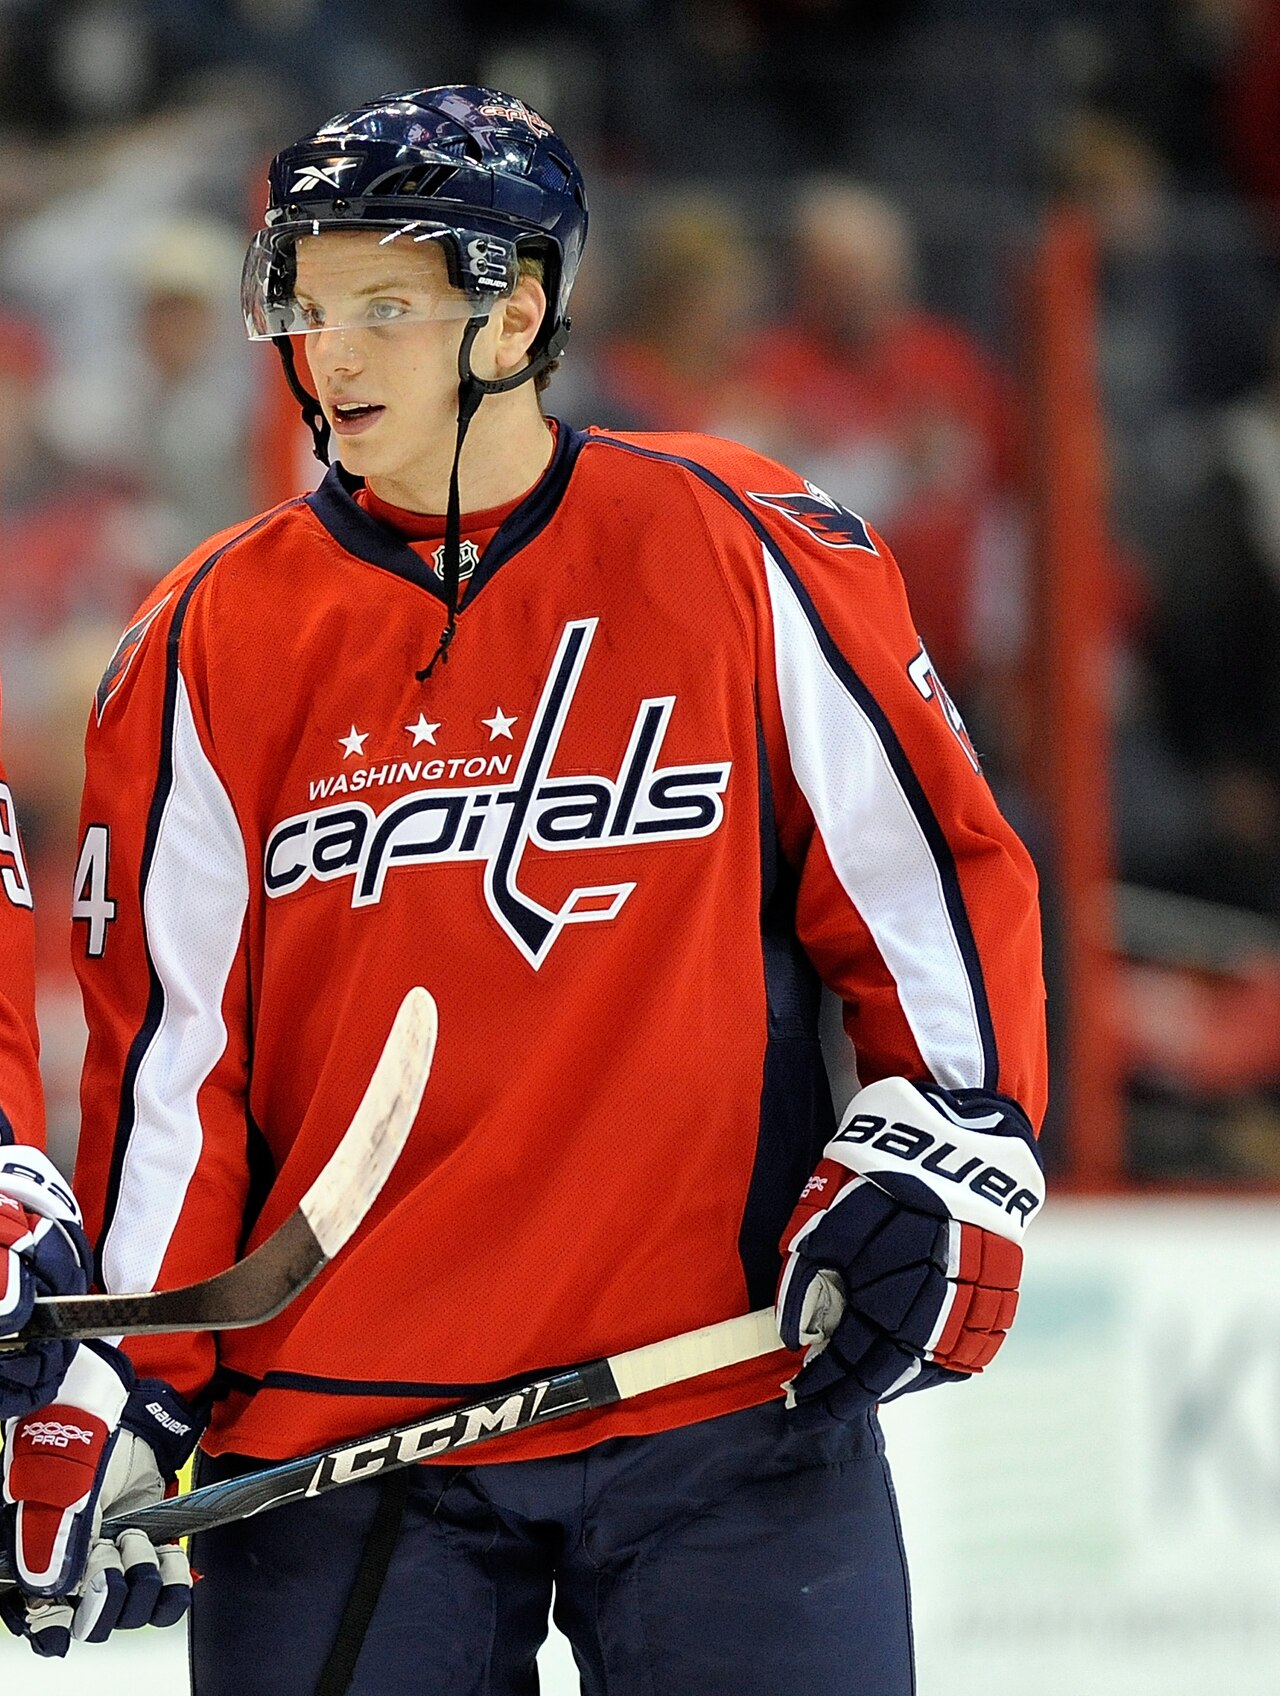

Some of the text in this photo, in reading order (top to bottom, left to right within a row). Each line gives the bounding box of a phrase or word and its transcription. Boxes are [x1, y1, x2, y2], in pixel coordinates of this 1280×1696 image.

[264, 617, 732, 972] capitals
[309, 755, 512, 801] WASHINGTON
[72, 823, 118, 960] 4
[832, 1113, 1040, 1228] BAUER
[31, 1435, 69, 1448] PRO
[145, 1402, 191, 1436] BAUER
[328, 1394, 524, 1484] CCM
